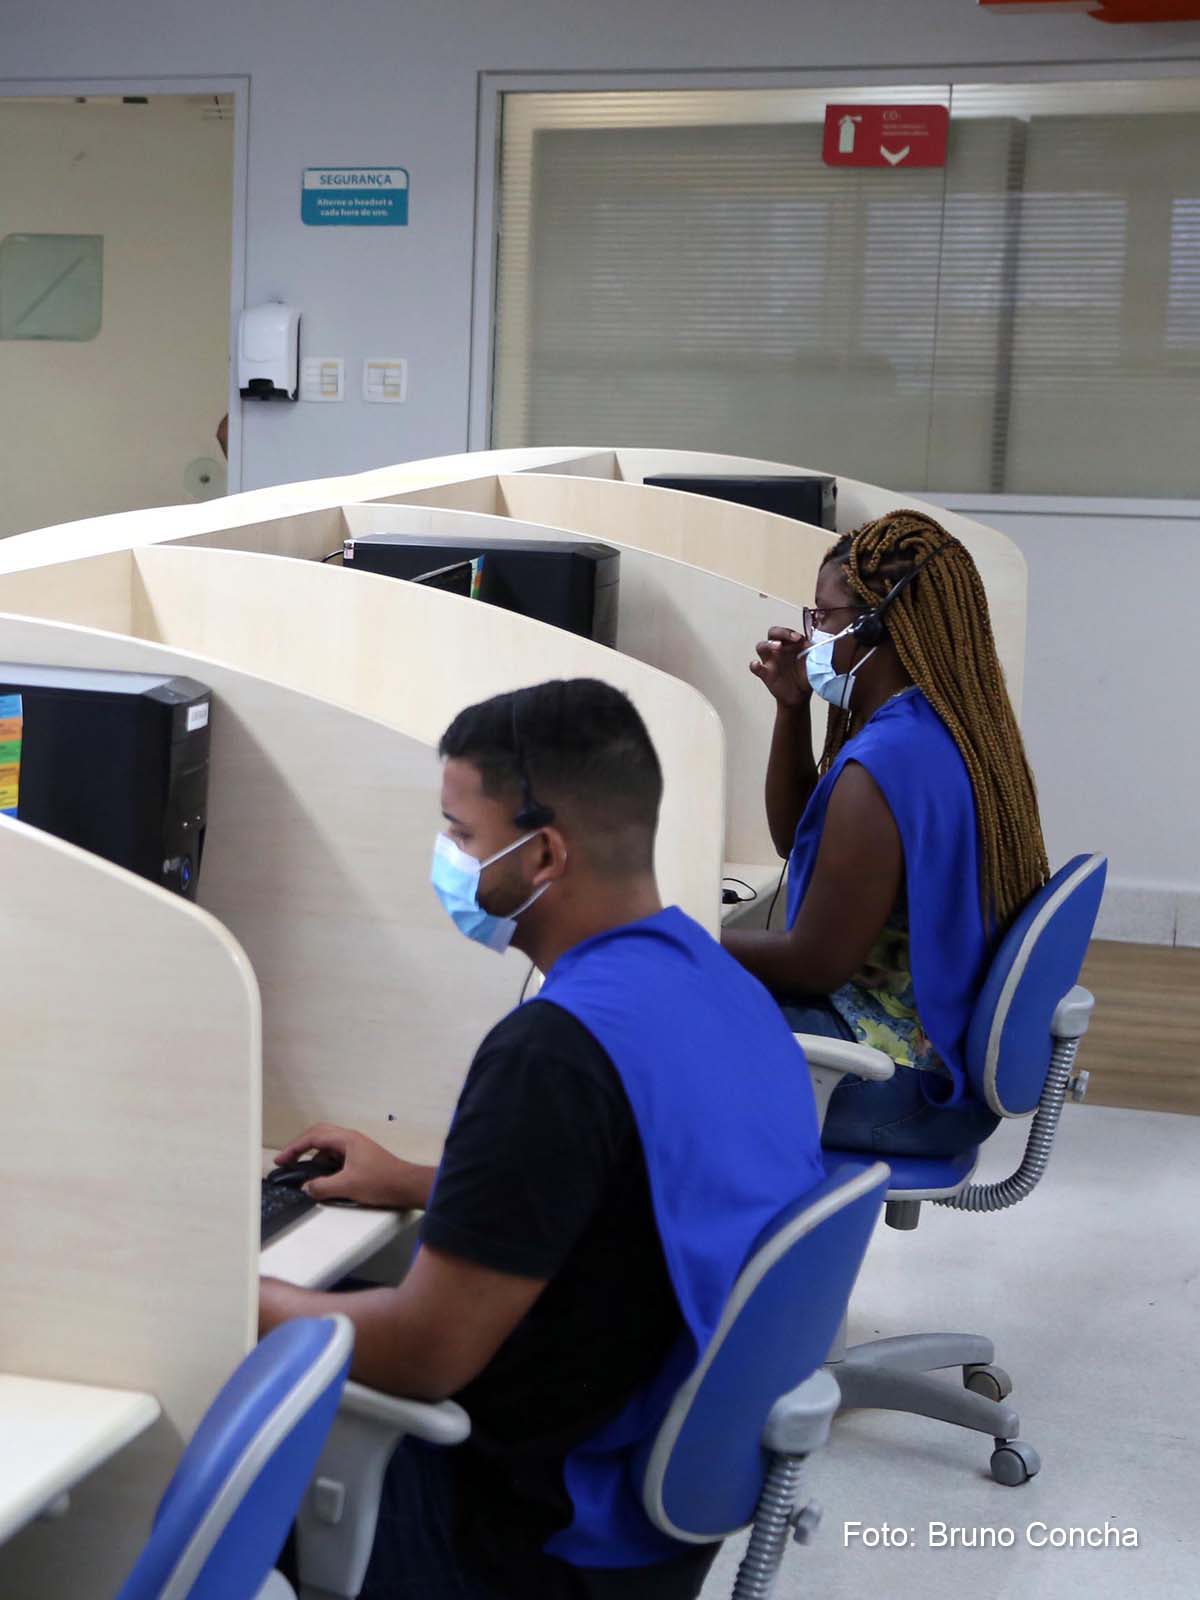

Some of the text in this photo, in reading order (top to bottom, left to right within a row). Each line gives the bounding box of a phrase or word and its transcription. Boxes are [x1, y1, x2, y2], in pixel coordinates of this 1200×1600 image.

[320, 174, 392, 187] SEGURANÇA
[355, 198, 386, 207] headset
[320, 209, 339, 217] cada
[341, 209, 359, 217] hora
[361, 209, 371, 217] de
